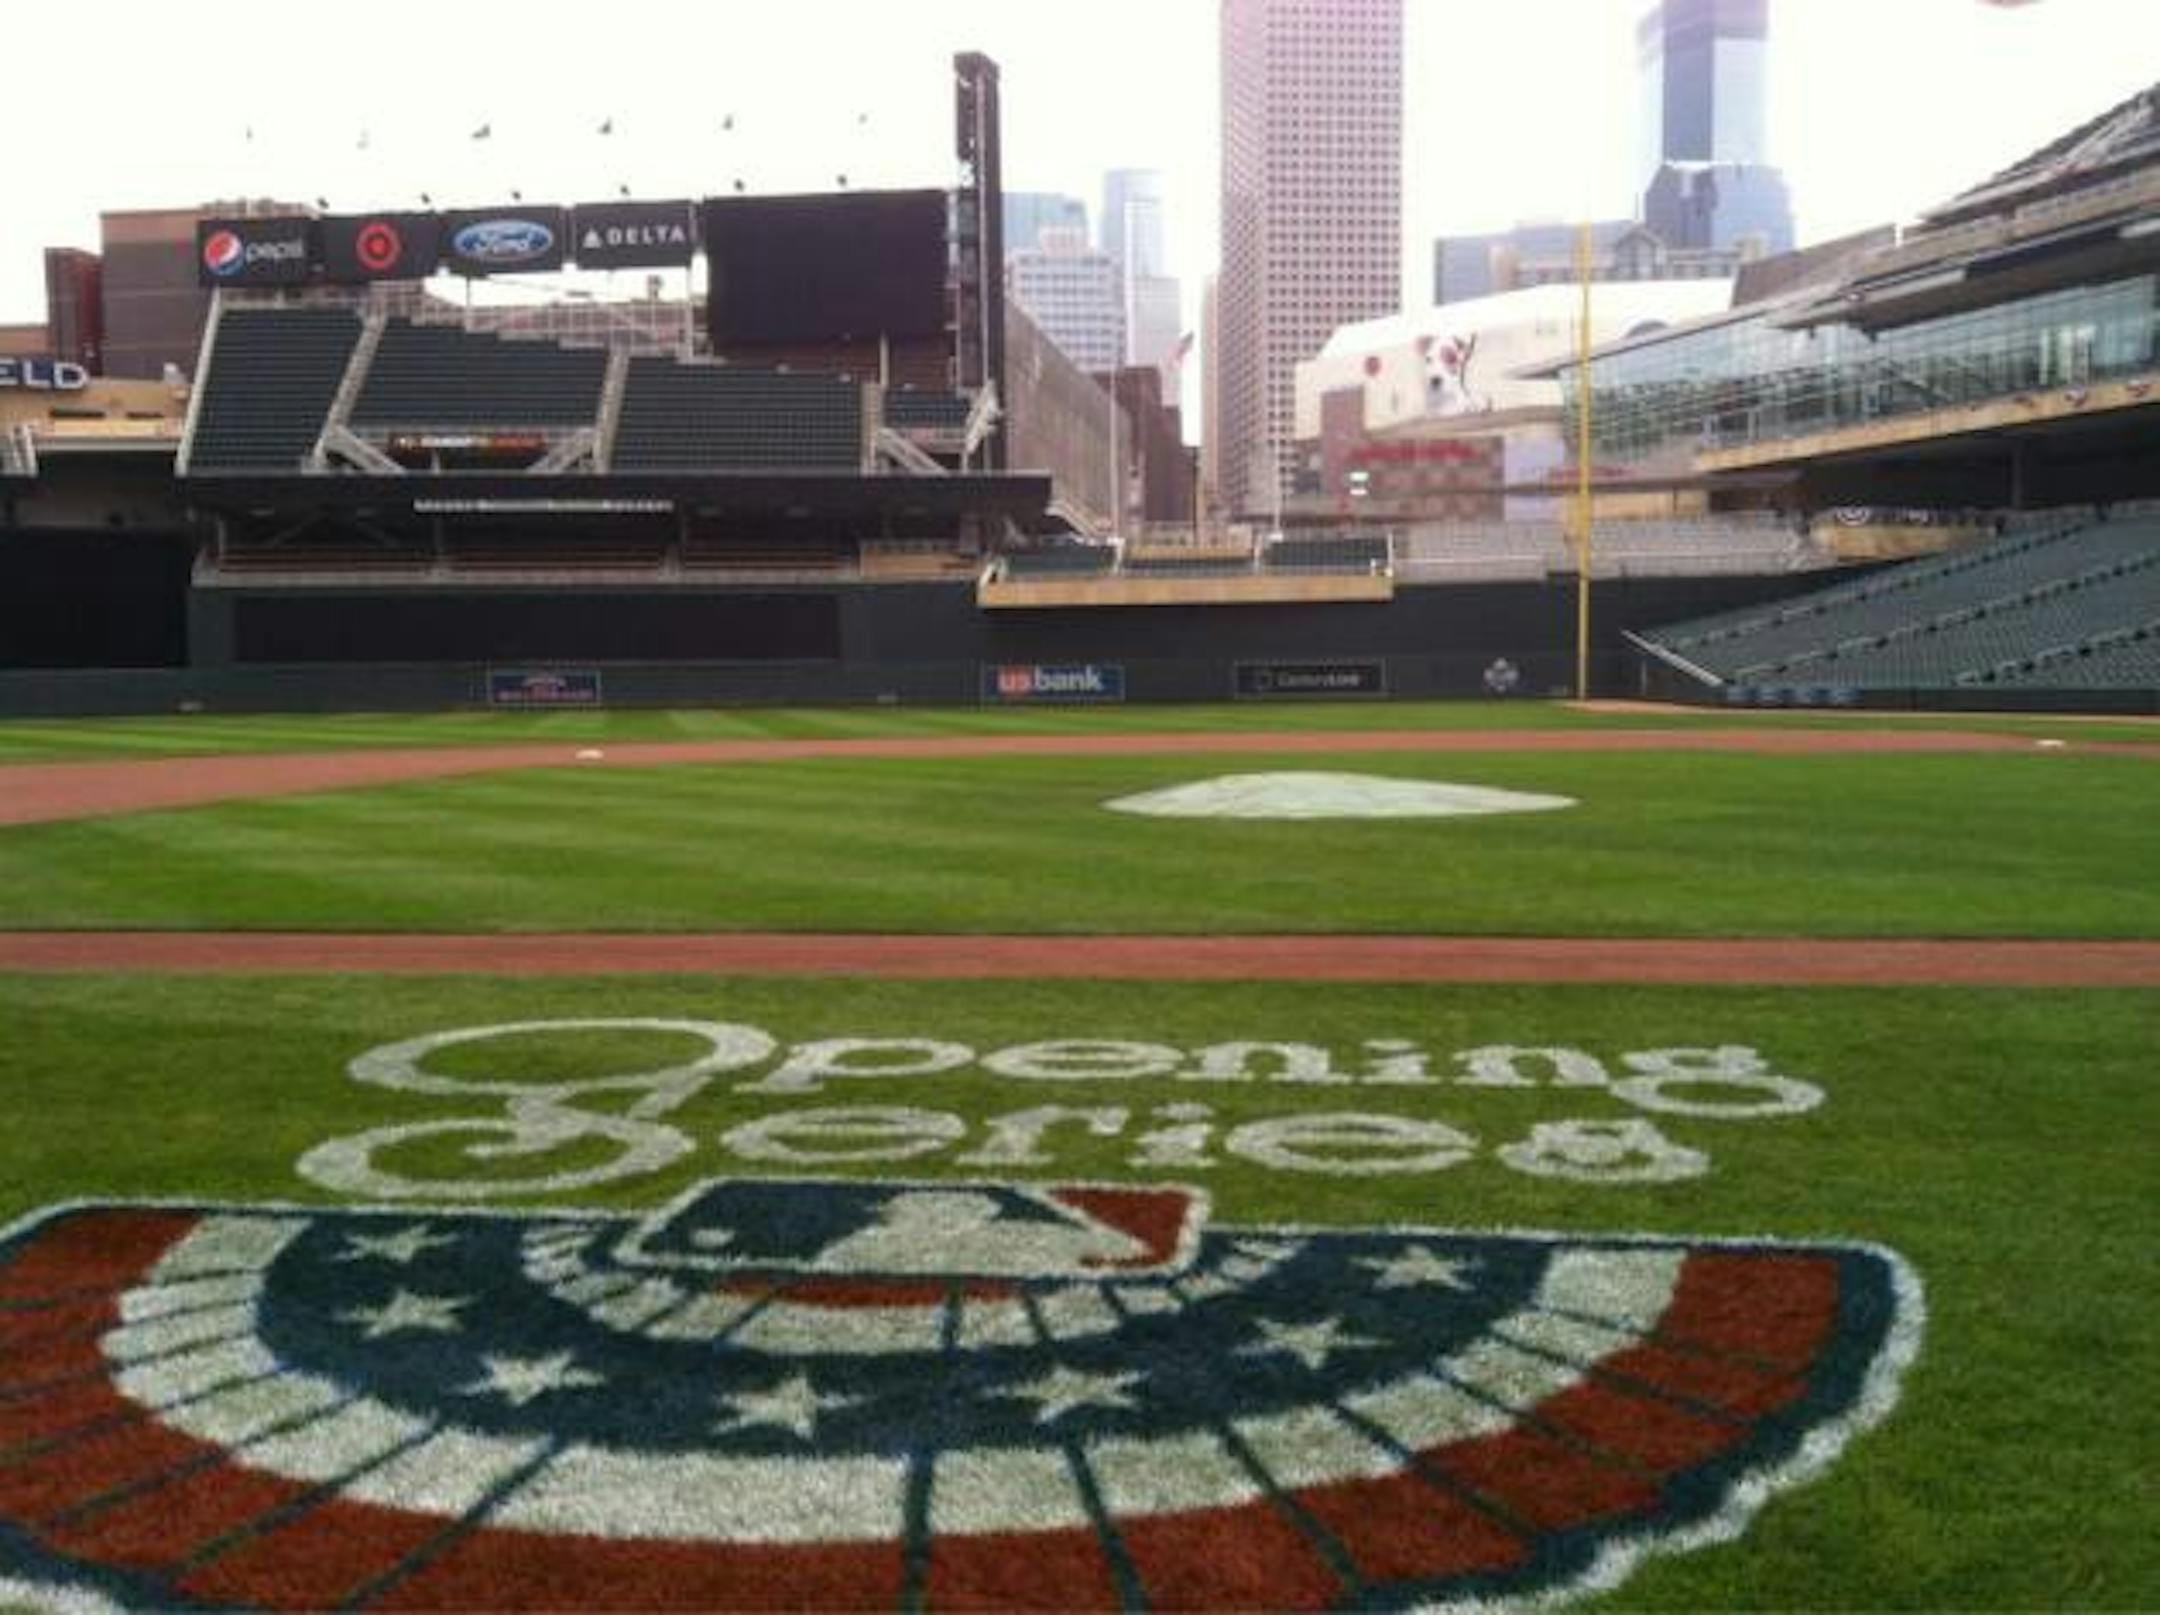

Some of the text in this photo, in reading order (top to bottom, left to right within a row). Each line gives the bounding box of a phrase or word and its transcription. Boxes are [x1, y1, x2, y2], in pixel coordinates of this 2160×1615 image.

[472, 230, 531, 254] Ford
[606, 225, 687, 246] DELTA
[246, 241, 304, 264] pepsi
[347, 1018, 1825, 1117] Opening
[295, 1095, 1710, 1198] Series
